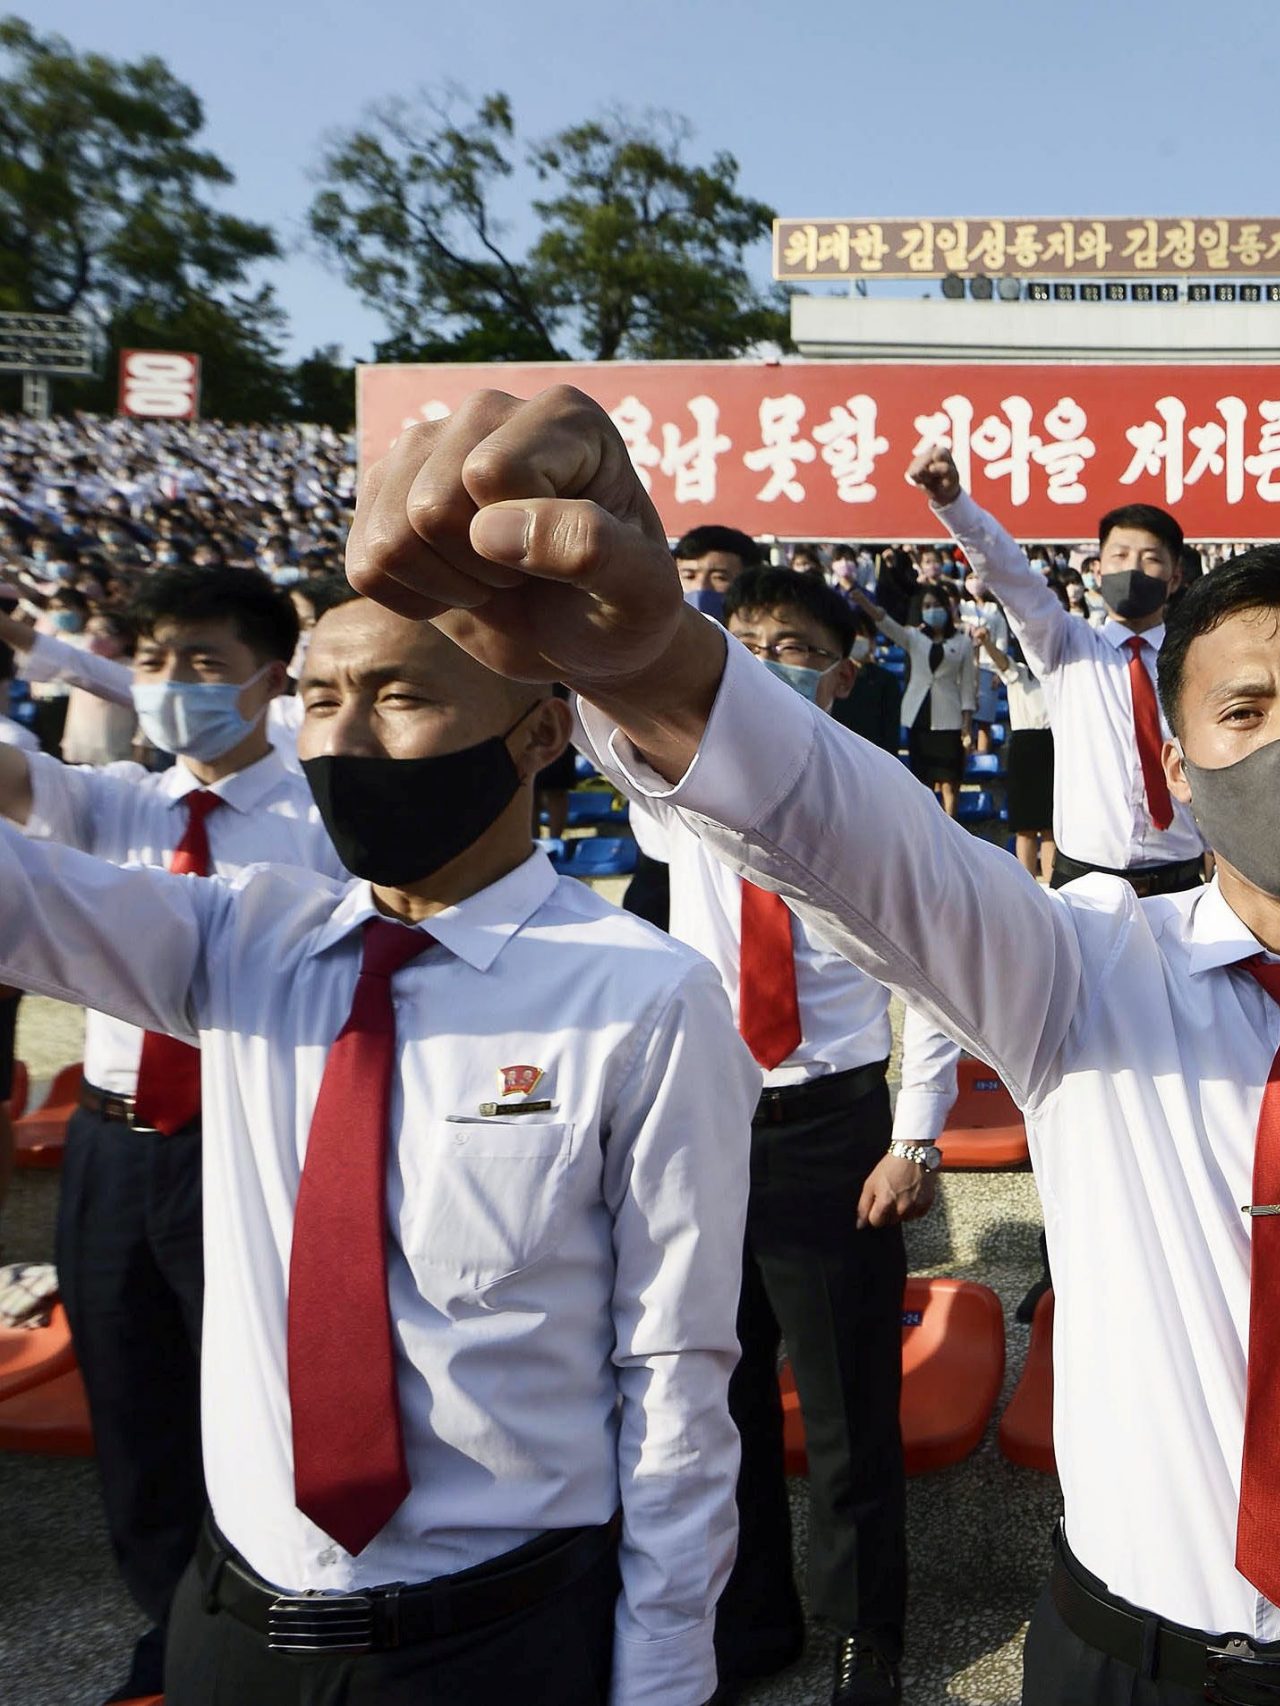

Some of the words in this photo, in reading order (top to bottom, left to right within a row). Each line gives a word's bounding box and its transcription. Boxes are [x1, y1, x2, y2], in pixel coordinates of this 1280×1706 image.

[784, 223, 890, 272] 위대한
[897, 222, 1113, 272] 김일성동지와
[743, 394, 888, 503] 못할
